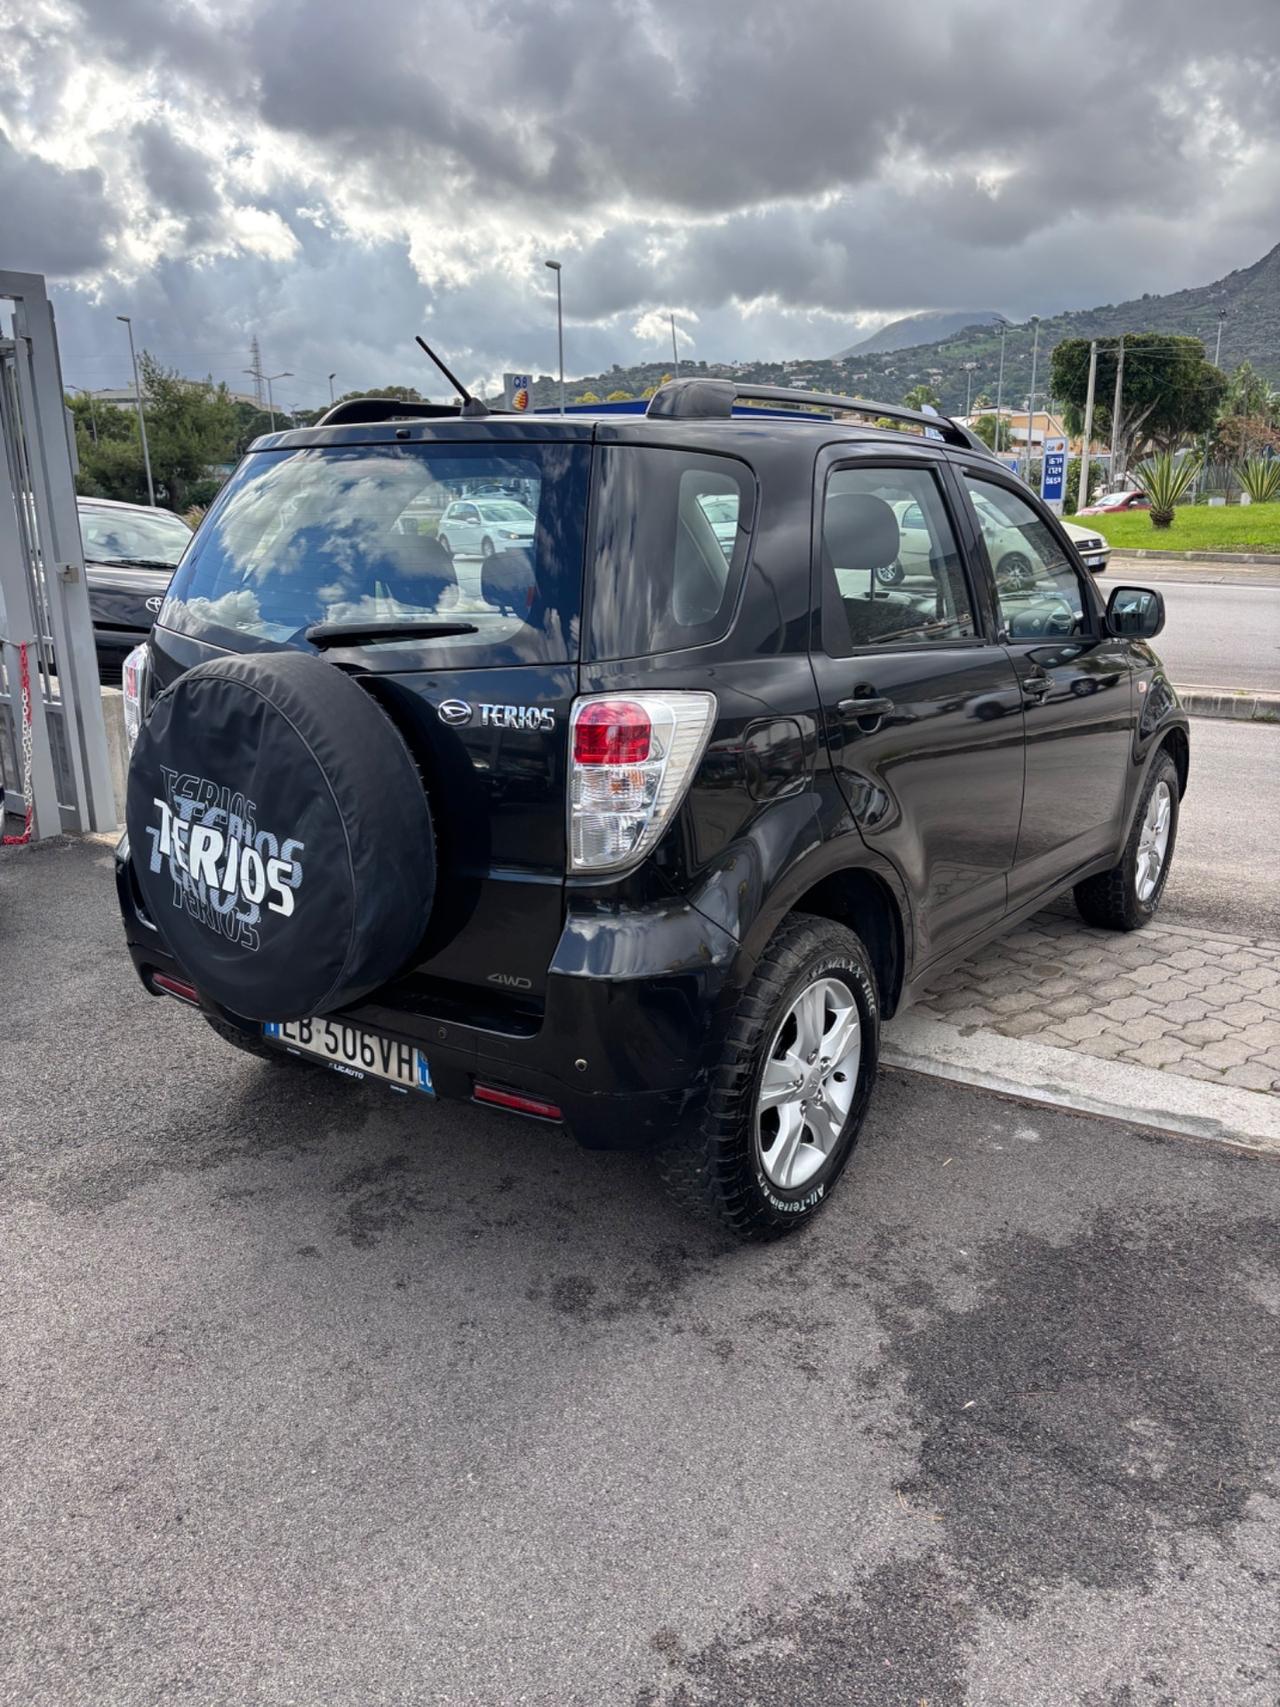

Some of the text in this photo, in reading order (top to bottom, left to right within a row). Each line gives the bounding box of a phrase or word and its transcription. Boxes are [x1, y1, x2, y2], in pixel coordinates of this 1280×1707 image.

[513, 376, 528, 389] Q8
[478, 703, 555, 731] TERIOS
[153, 797, 295, 918] TERIOS
[487, 973, 532, 989] 4WD
[324, 1020, 414, 1082] 506VH
[769, 1183, 825, 1212] All-Terrain
